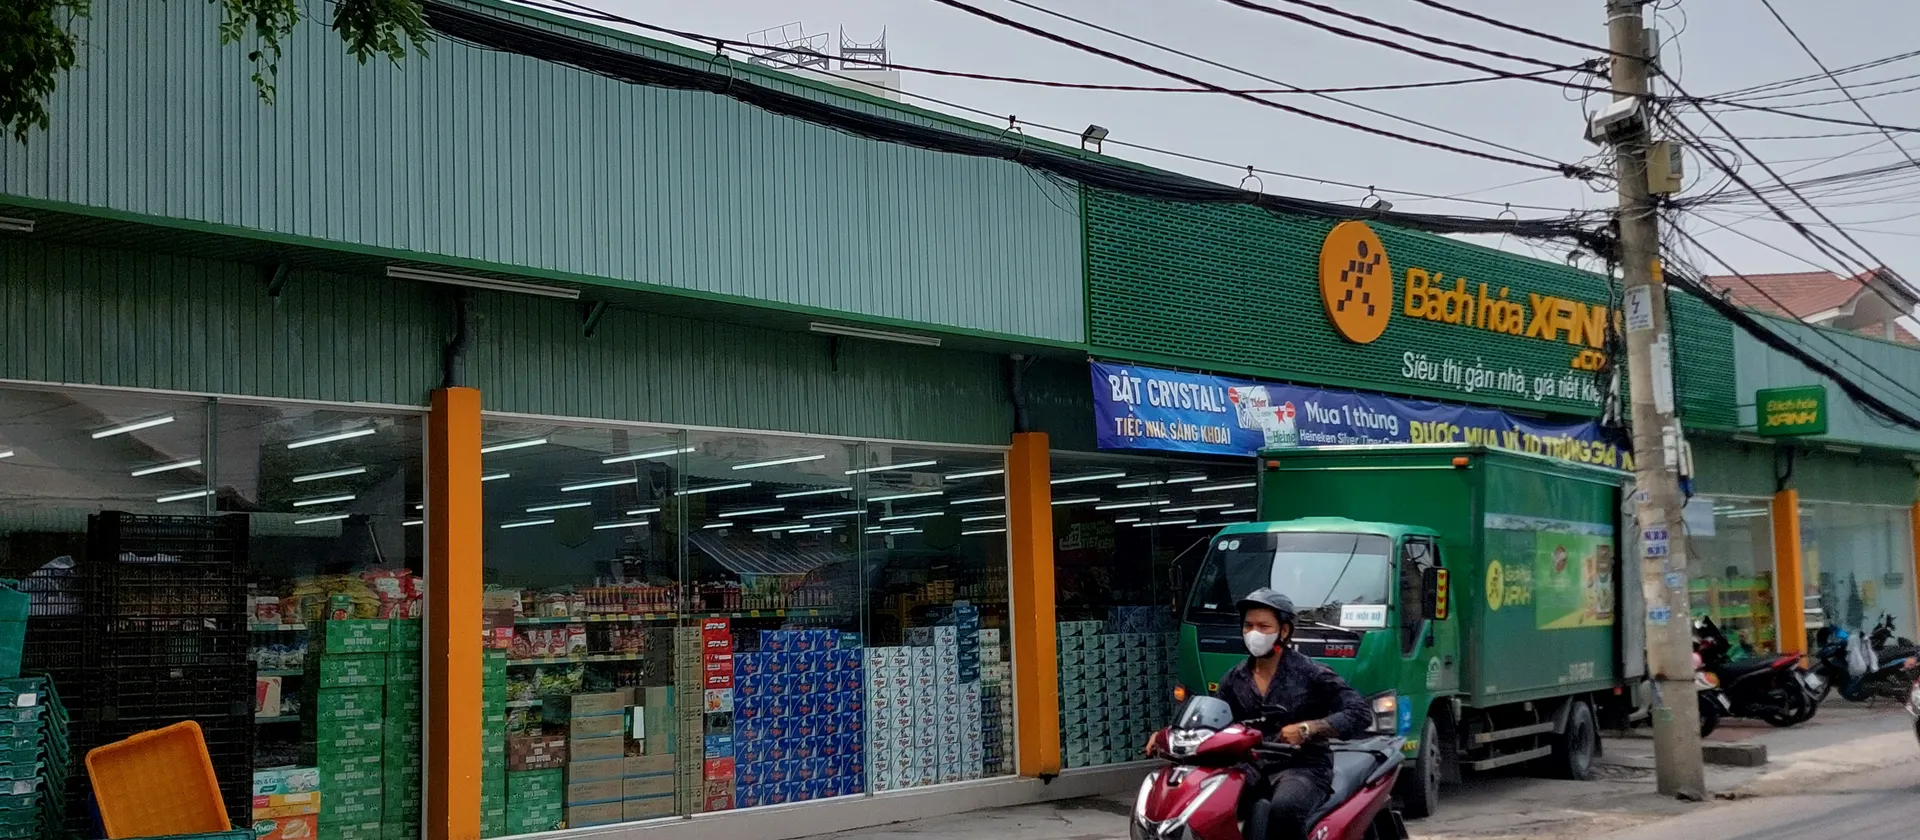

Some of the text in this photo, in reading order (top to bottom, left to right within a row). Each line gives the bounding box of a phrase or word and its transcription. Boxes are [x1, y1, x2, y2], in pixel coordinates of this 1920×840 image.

[1404, 266, 1475, 326] Bách
[1476, 283, 1524, 335] hóa
[1109, 370, 1227, 413] BẬT CRYSTAL!
[1402, 351, 1601, 407] Siêu thị gần nhà, giá tiết kiệ
[1115, 413, 1231, 445] TIỆC NHÀ SẢNG KHOÁI
[1300, 429, 1336, 443] Heineken
[1304, 401, 1400, 436] Mua 1 thùng
[1464, 426, 1498, 447] MUA
